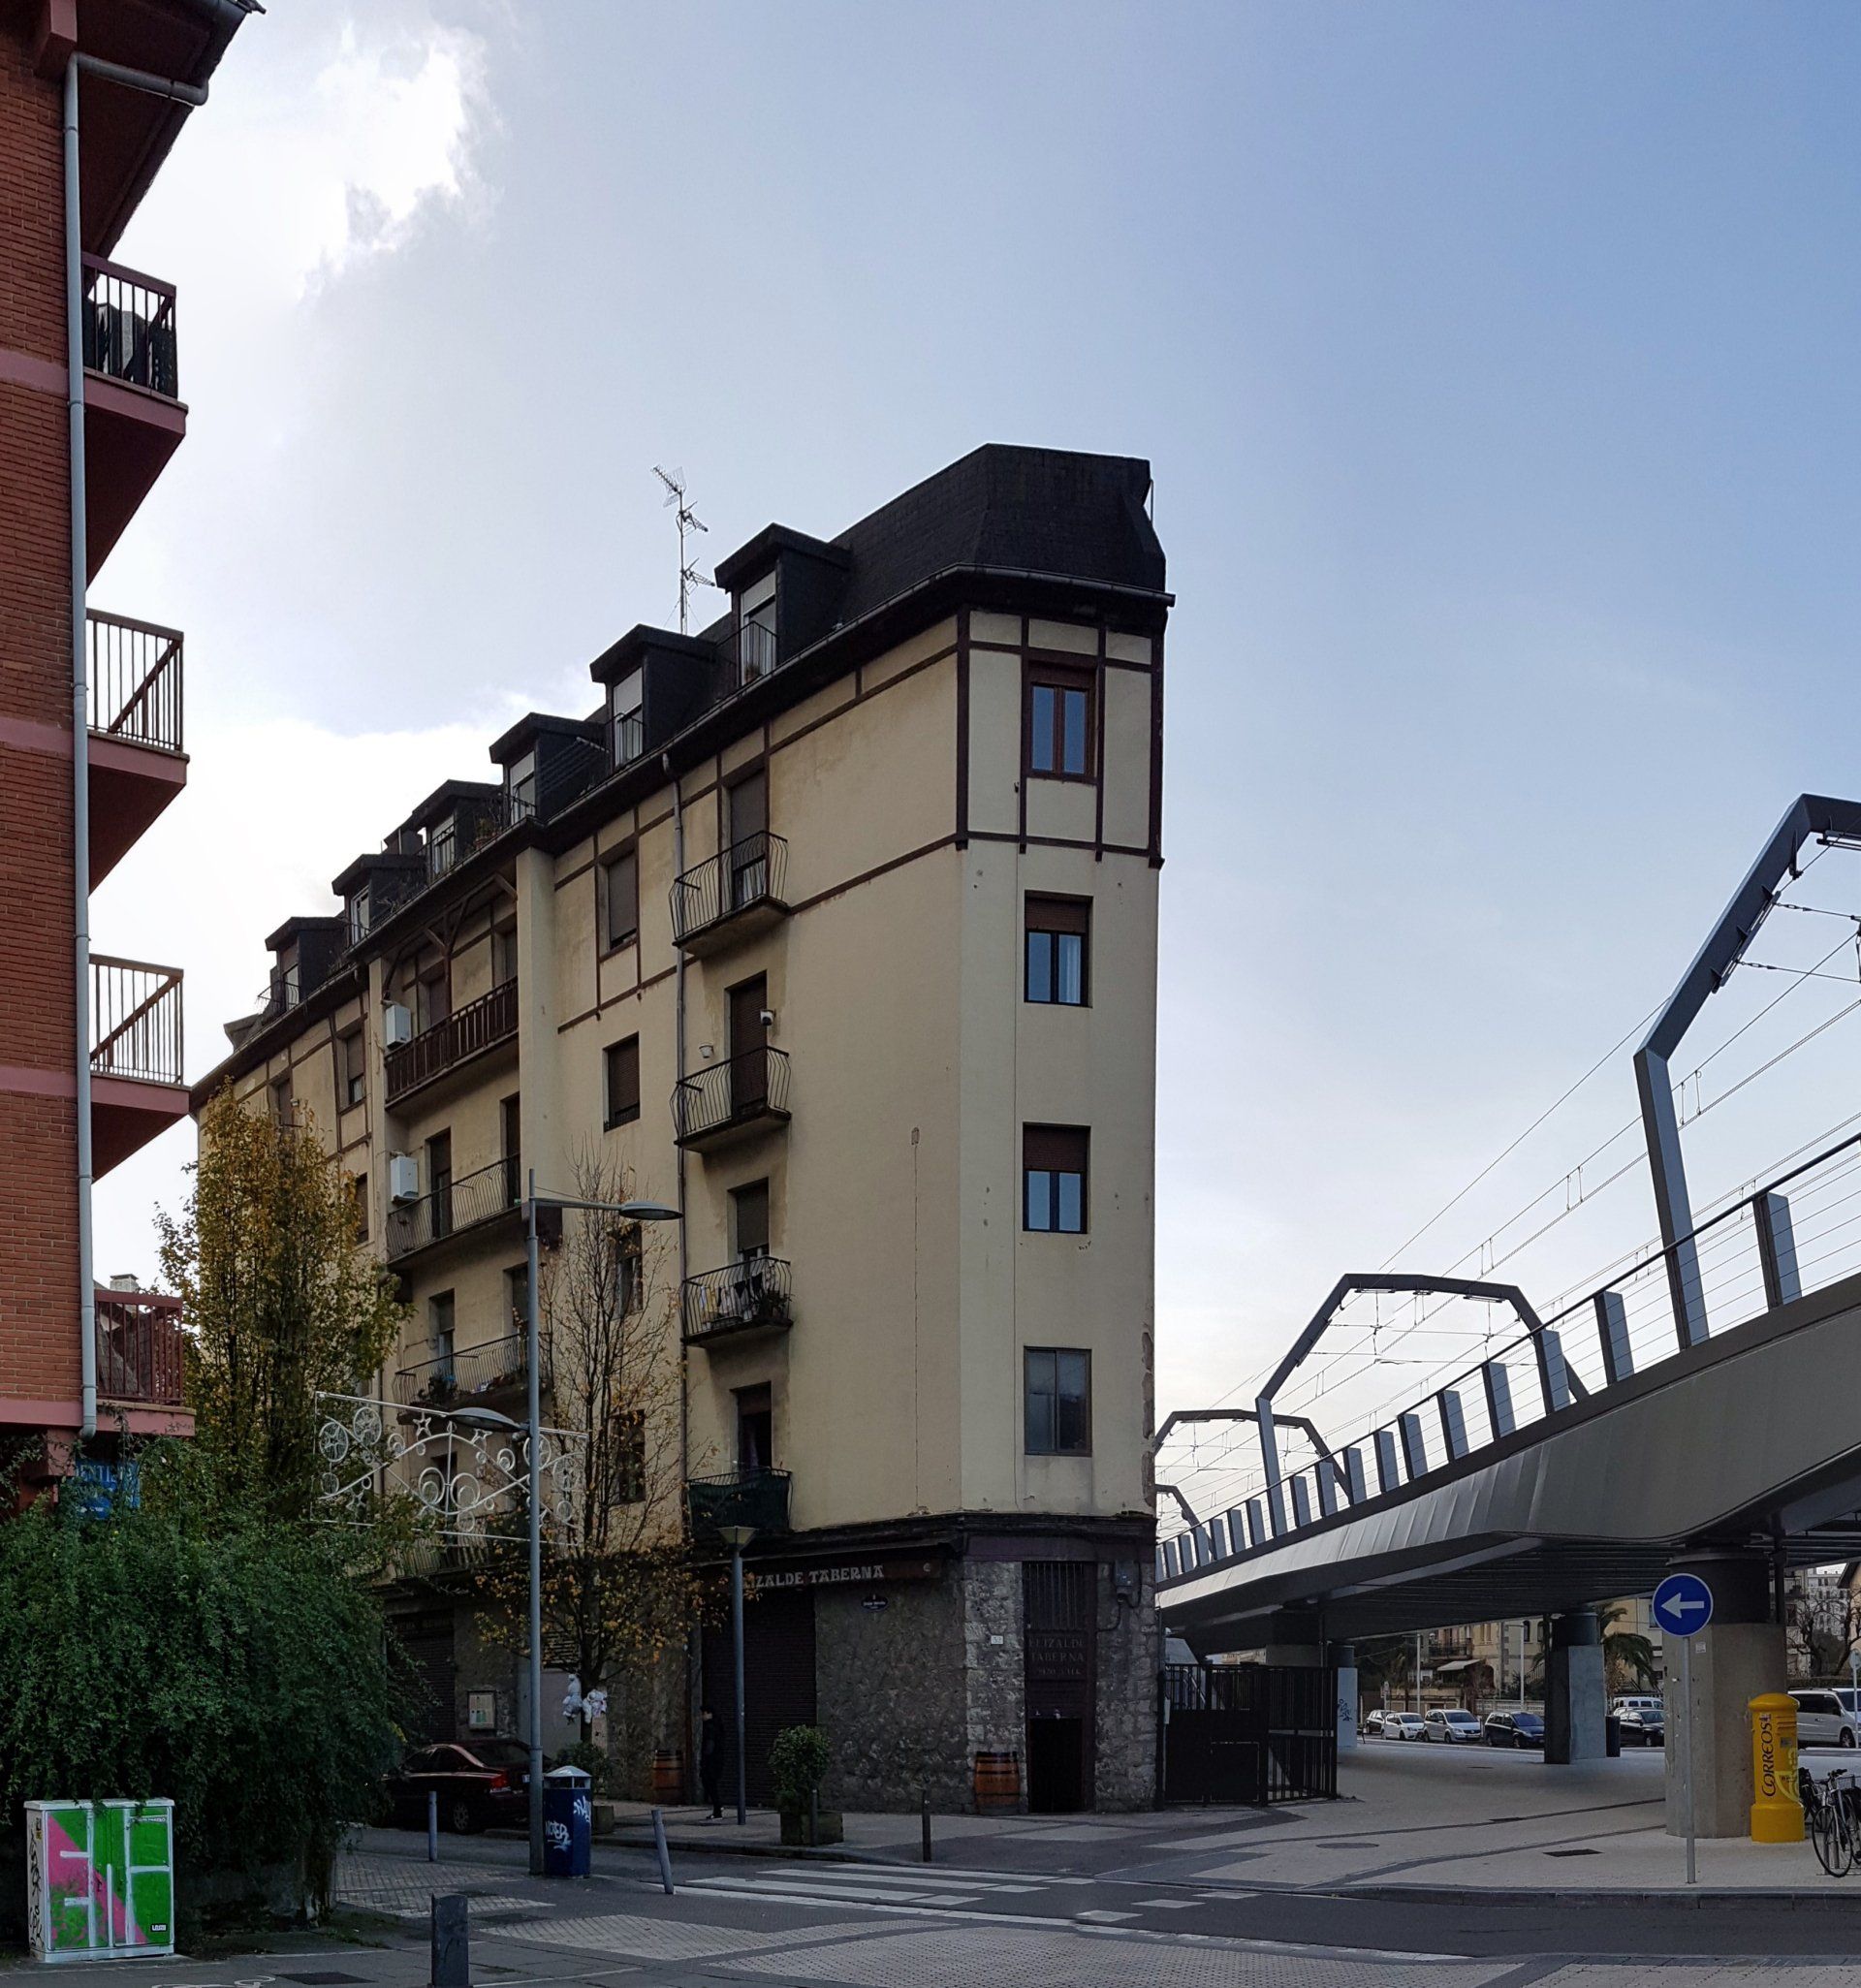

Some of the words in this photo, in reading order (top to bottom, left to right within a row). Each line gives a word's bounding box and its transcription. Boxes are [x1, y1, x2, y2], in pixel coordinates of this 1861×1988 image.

[749, 1570, 804, 1589] ZALDE
[809, 1564, 885, 1584] TABERNA
[1031, 1652, 1085, 1662] TABERNA
[1760, 1721, 1776, 1797] CORREOS
